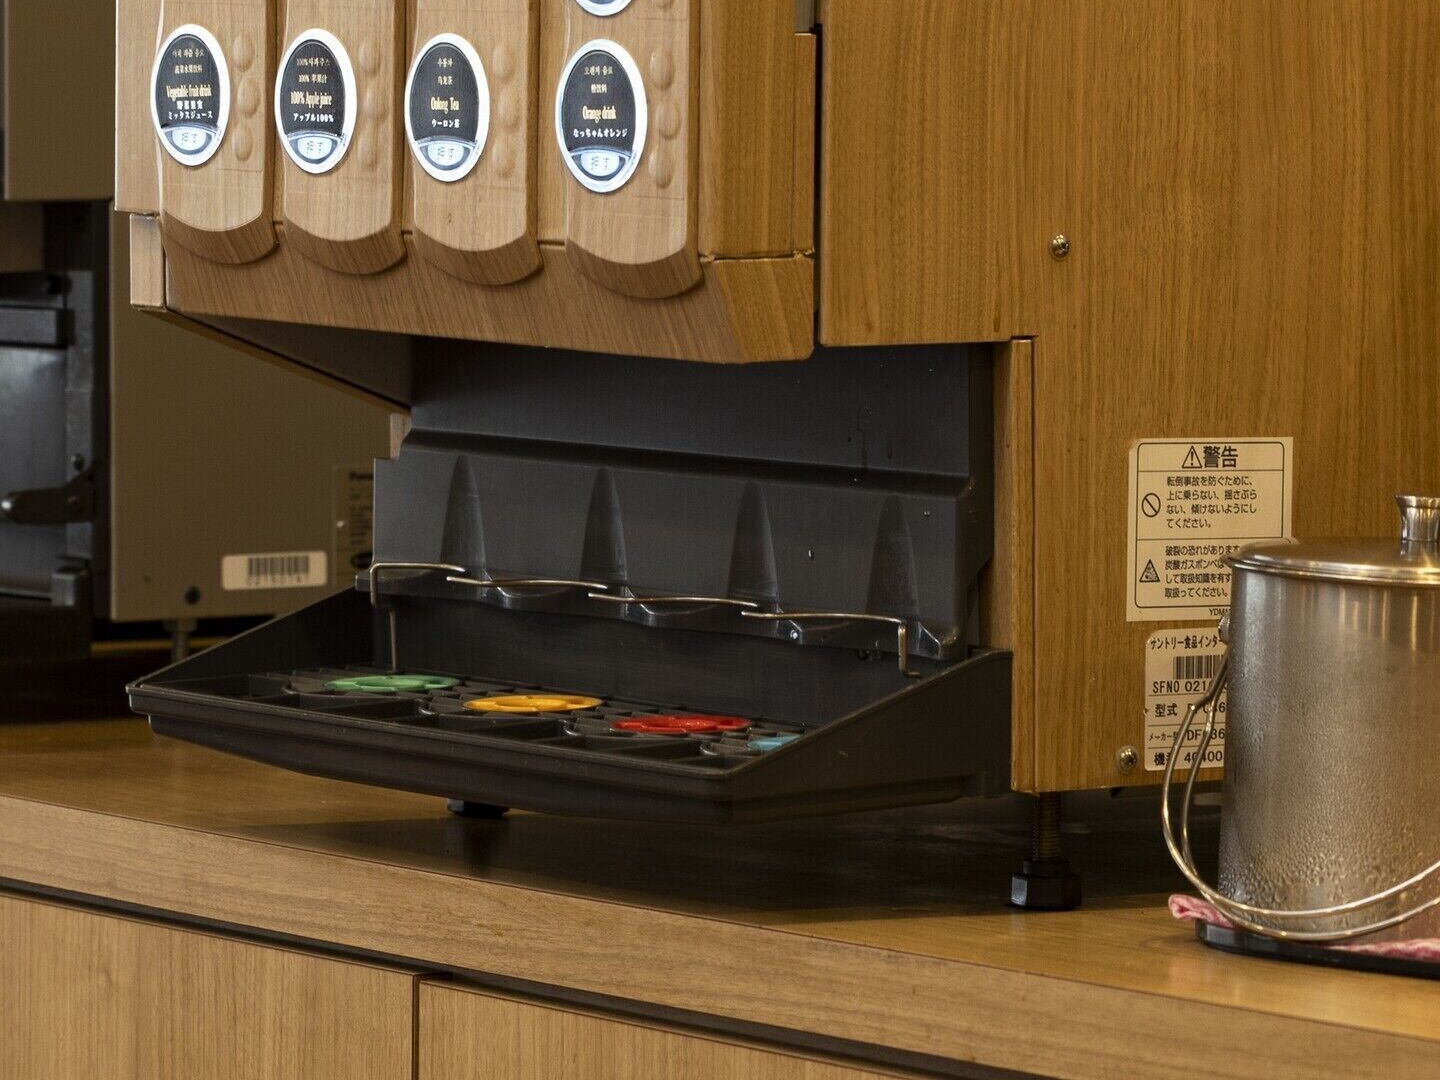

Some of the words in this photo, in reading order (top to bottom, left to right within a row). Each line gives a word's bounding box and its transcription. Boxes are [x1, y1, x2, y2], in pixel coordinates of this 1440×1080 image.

[166, 85, 188, 101] Vegetable
[291, 92, 304, 104] 100%
[306, 92, 319, 108] Apple
[319, 92, 332, 108] juice
[431, 97, 448, 114] Oolong
[450, 97, 459, 110] Tea
[168, 111, 212, 120] ミックスジュース
[293, 113, 334, 122] アップル100%
[582, 106, 601, 123] Orange
[602, 105, 616, 119] drink
[432, 119, 460, 128] ウーロン茶
[573, 128, 627, 138] なっちゃんオレンジ
[1203, 446, 1238, 468] 警告
[1167, 476, 1253, 486] 転倒事故を防ぐために、
[1166, 504, 1257, 514] ない、傾けないようにし
[1166, 518, 1211, 528] てください。
[1165, 587, 1228, 599] 取扱ってください。
[1155, 703, 1178, 717] 型式
[1187, 728, 1225, 741] DF36
